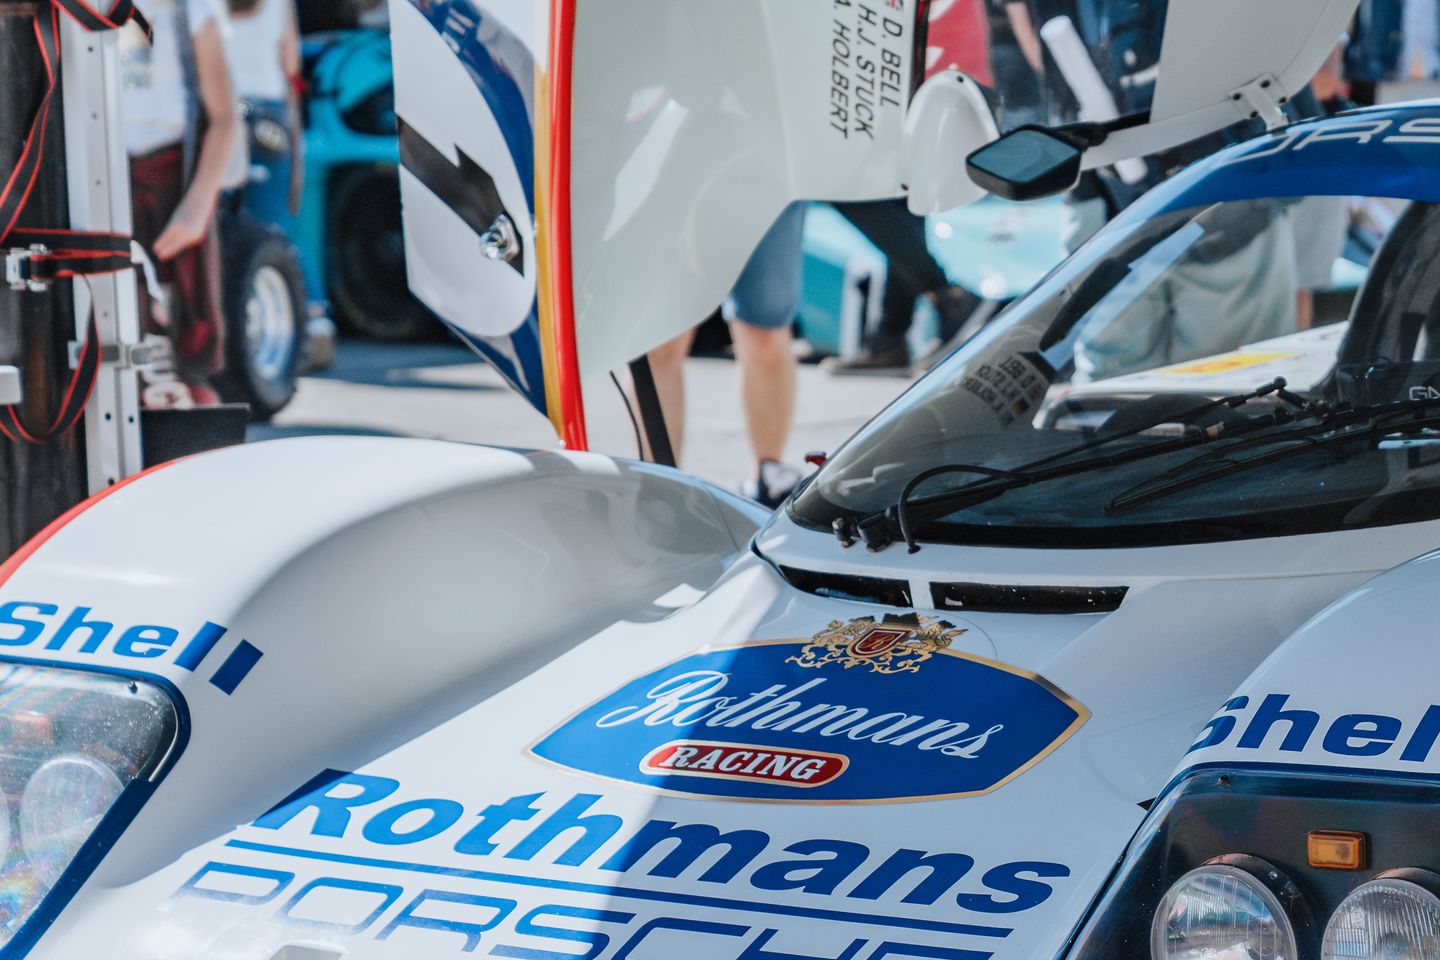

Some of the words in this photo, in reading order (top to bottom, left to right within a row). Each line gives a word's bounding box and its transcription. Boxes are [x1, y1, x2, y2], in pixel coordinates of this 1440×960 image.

[882, 17, 903, 39] D.
[830, 19, 850, 139] HOLBERT
[855, 55, 875, 140] STUCK
[880, 48, 901, 107] BELL
[0, 601, 264, 696] Shell
[596, 671, 1004, 759] Rothmans
[658, 746, 828, 781] RACING
[252, 769, 1070, 914] Rothmans
